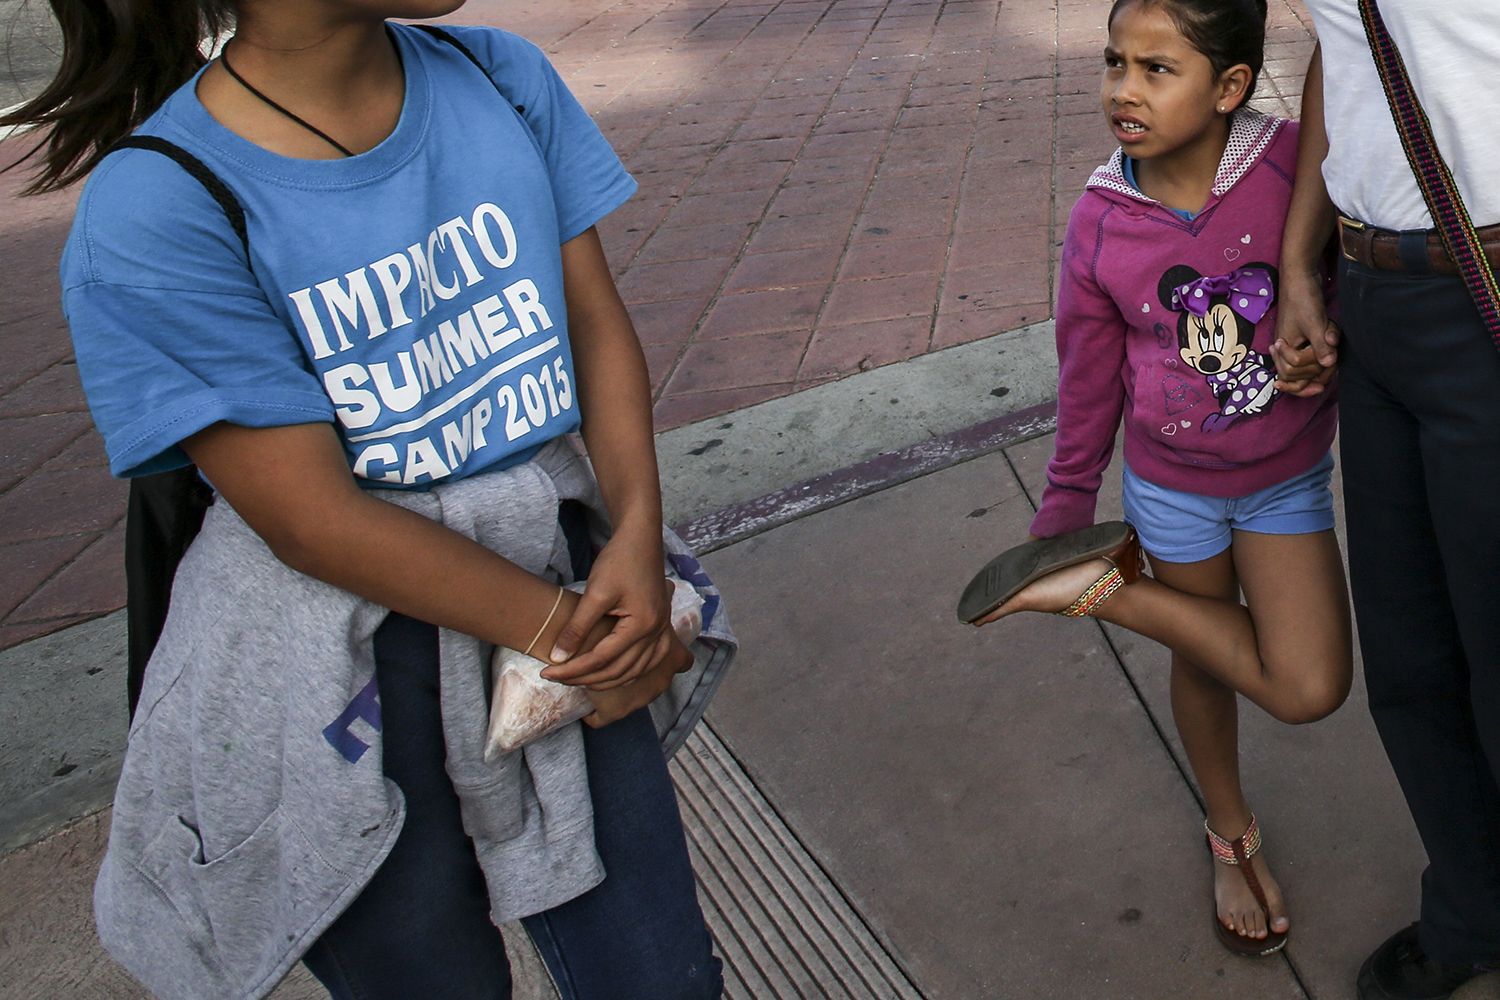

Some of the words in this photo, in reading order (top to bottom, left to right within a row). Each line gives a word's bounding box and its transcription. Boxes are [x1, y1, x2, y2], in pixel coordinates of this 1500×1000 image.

[288, 202, 518, 360] IMPACTO
[323, 278, 554, 430] SUMMER
[353, 398, 493, 485] CAMP
[499, 355, 574, 443] 2015
